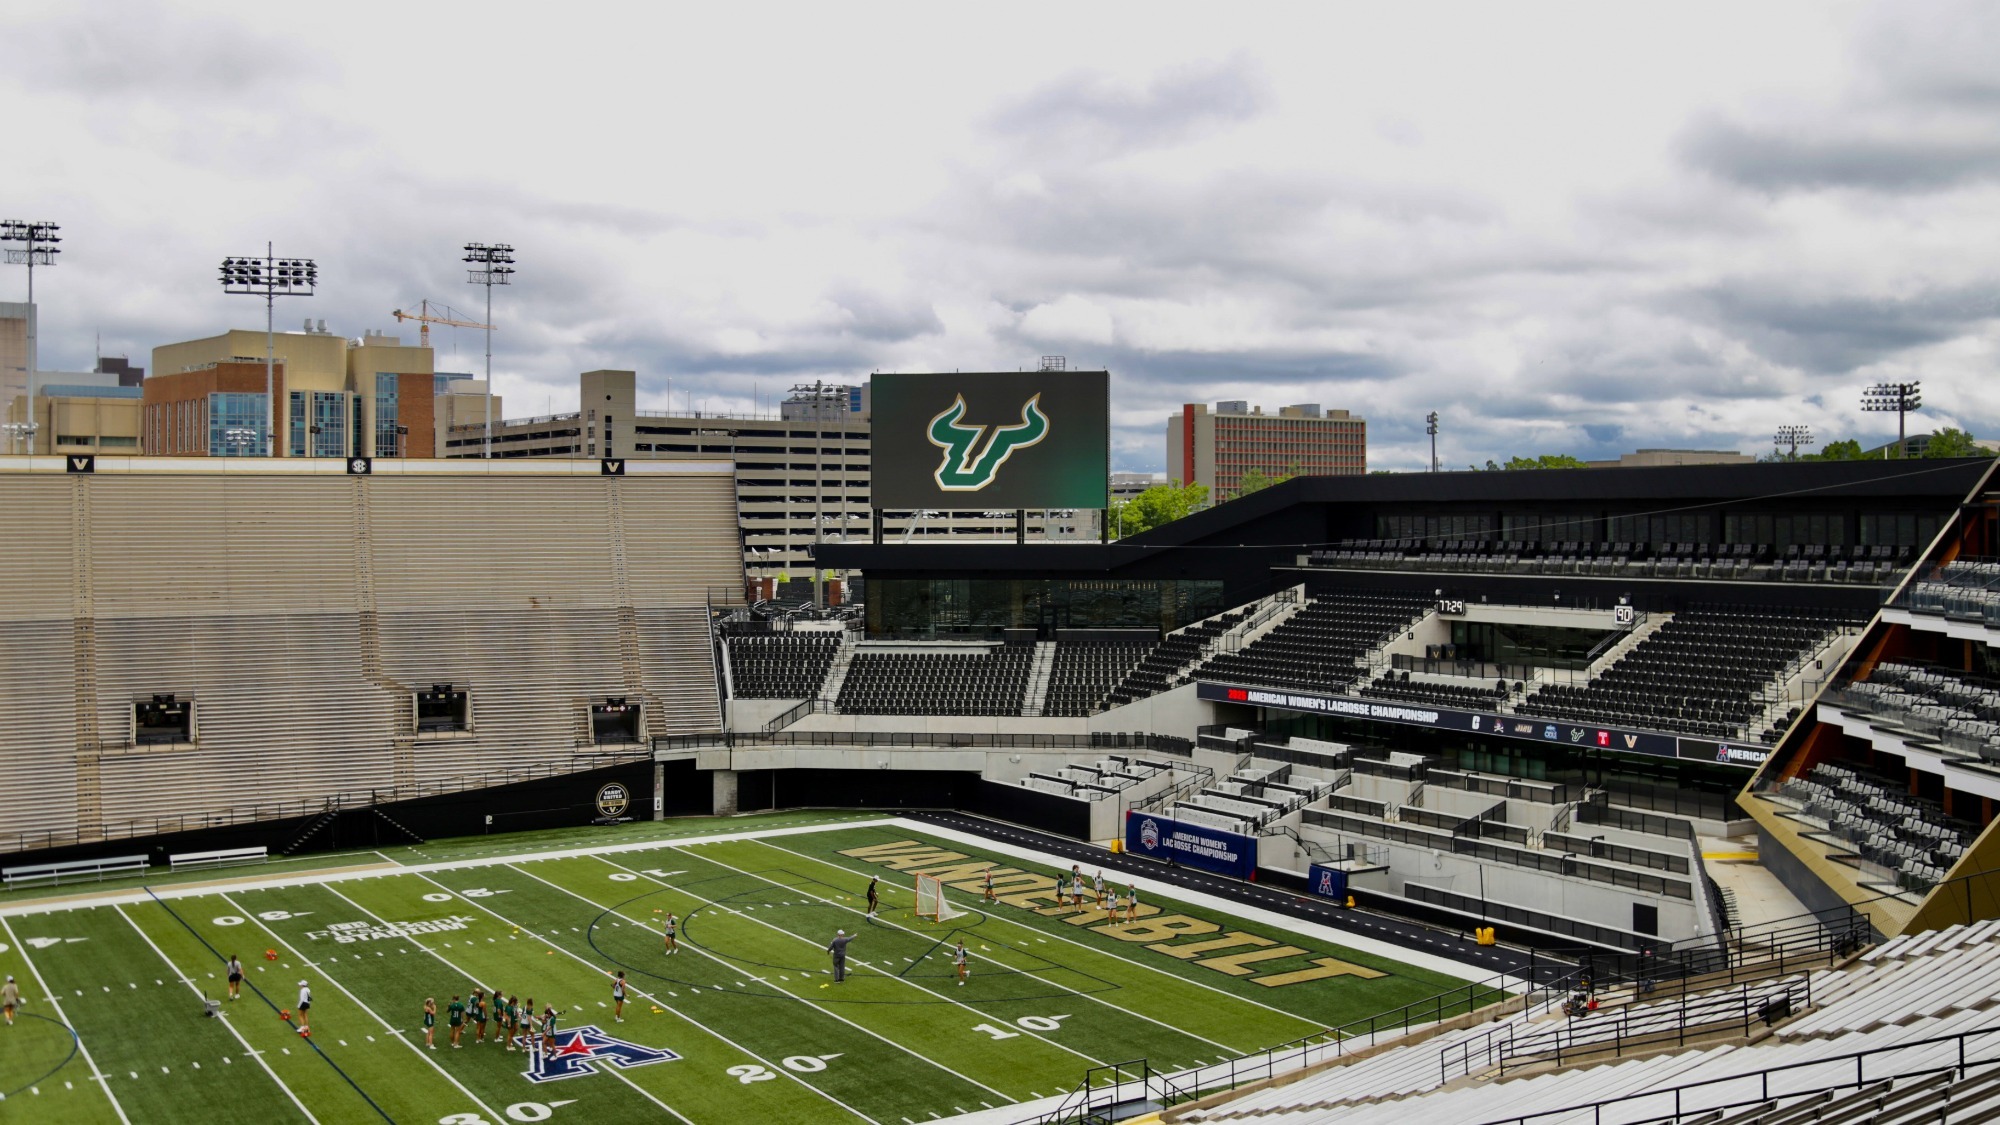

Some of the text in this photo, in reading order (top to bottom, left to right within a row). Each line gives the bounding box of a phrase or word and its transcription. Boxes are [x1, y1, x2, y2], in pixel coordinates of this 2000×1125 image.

[73, 458, 88, 470] V
[352, 460, 367, 472] SEC
[606, 462, 620, 472] V
[1617, 608, 1630, 621] 90
[1248, 691, 1287, 706] AMERICAN
[1288, 696, 1326, 710] WOMEN'S
[1327, 700, 1370, 716] LACROSSE
[1371, 705, 1438, 723] CHAMPIONSHIP
[1598, 731, 1608, 745] T
[1624, 734, 1638, 749] V
[1163, 837, 1238, 862] LACROSSE CHAMPIONSHIP
[1173, 831, 1200, 845] AMERICAN
[1200, 837, 1227, 851] WOMEN'S
[834, 839, 1390, 987] VANDERBILT
[304, 915, 478, 940] FirstBank
[334, 922, 469, 943] STADIUM
